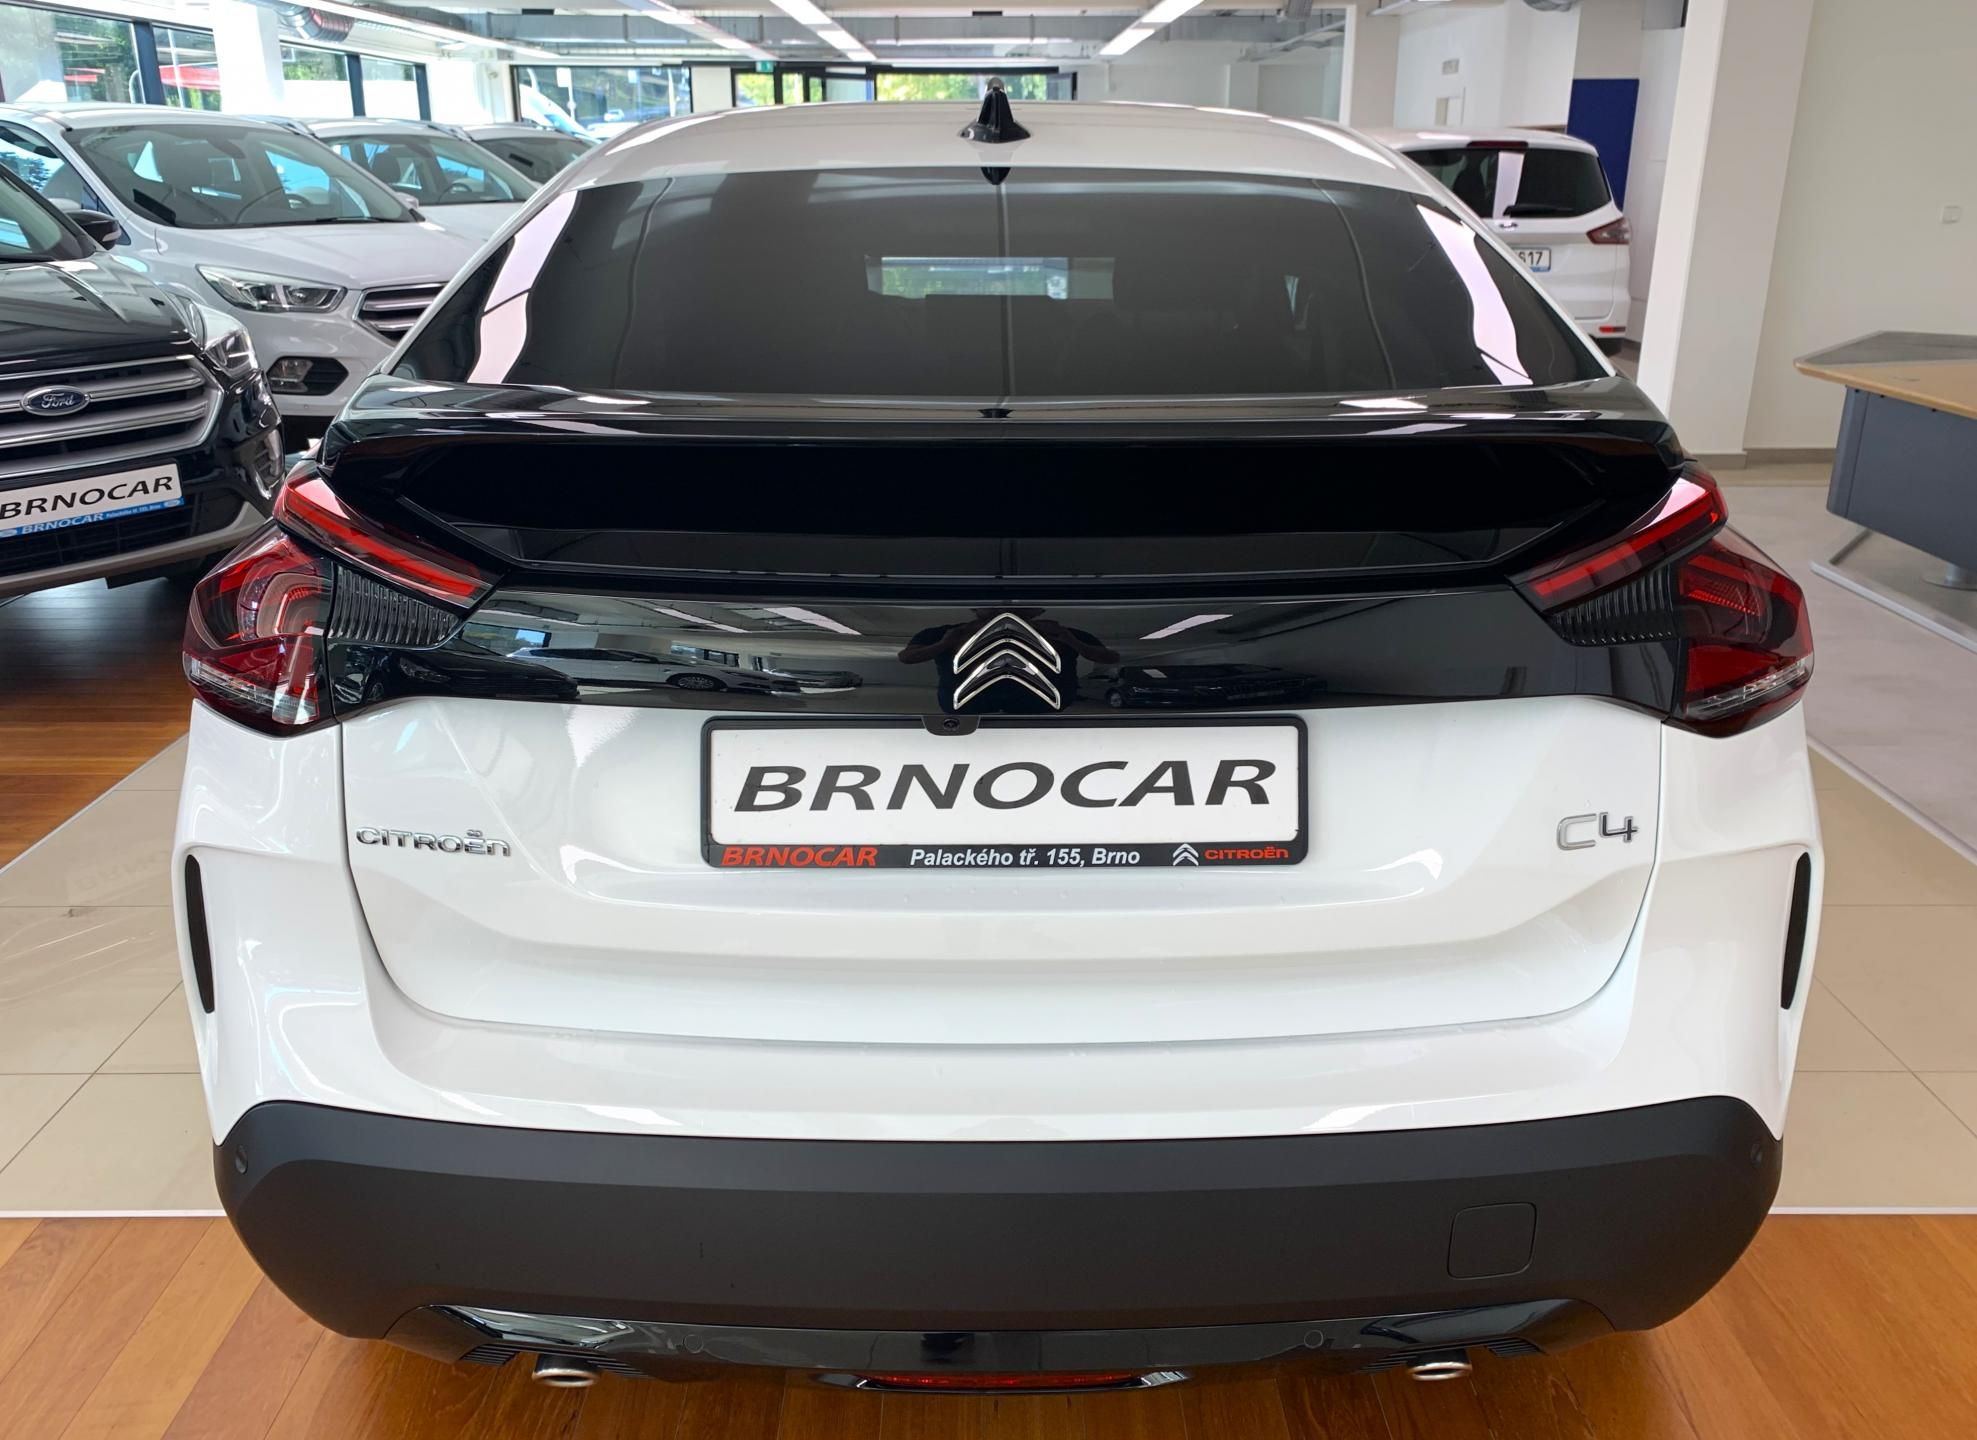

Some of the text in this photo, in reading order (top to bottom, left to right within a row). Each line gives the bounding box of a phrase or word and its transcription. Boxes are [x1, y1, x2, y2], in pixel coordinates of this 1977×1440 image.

[41, 393, 74, 408] Ford
[0, 476, 173, 520] BRNOCAR
[22, 513, 104, 535] BRNOCAR
[734, 759, 1277, 812] BRNOCAR
[1556, 812, 1639, 851] C4
[720, 847, 878, 867] BRNOCAR
[910, 848, 1013, 866] Palackého
[1019, 848, 1039, 866] tř.
[1046, 848, 1085, 867] 155,
[1091, 848, 1141, 865] Brno
